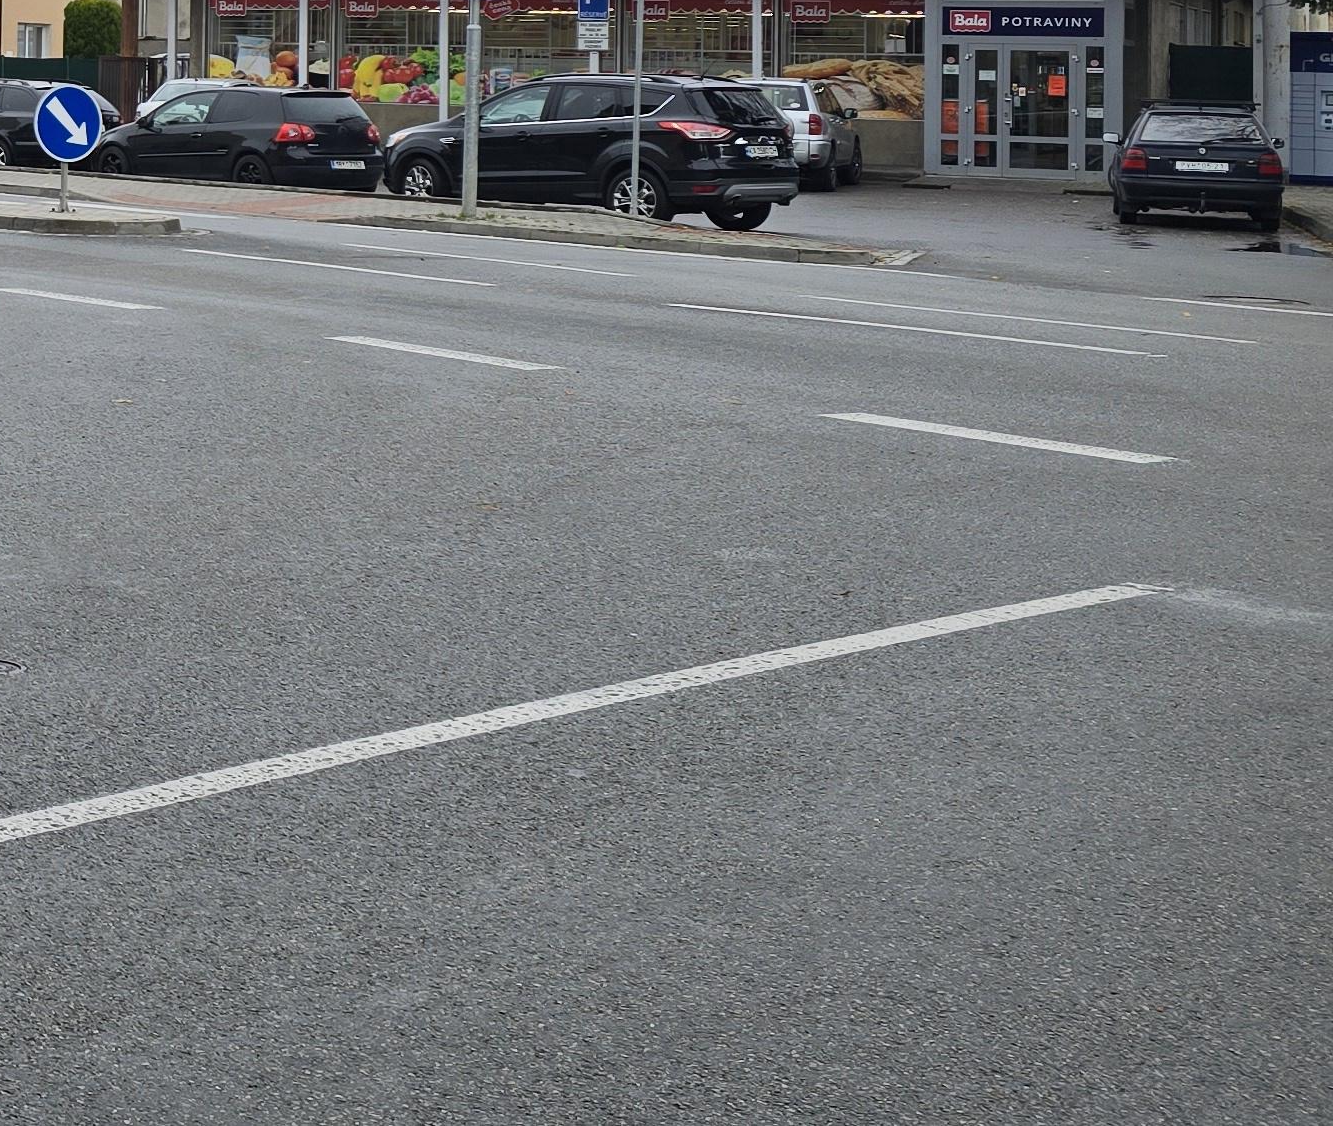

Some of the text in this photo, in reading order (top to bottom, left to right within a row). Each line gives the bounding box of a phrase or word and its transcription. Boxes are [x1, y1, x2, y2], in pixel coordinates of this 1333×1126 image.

[218, 0, 244, 11] Bala
[349, 1, 375, 12] Bala
[643, 4, 666, 16] ala
[794, 4, 827, 17] Bala
[954, 14, 1093, 28] Bala POTRAVINY
